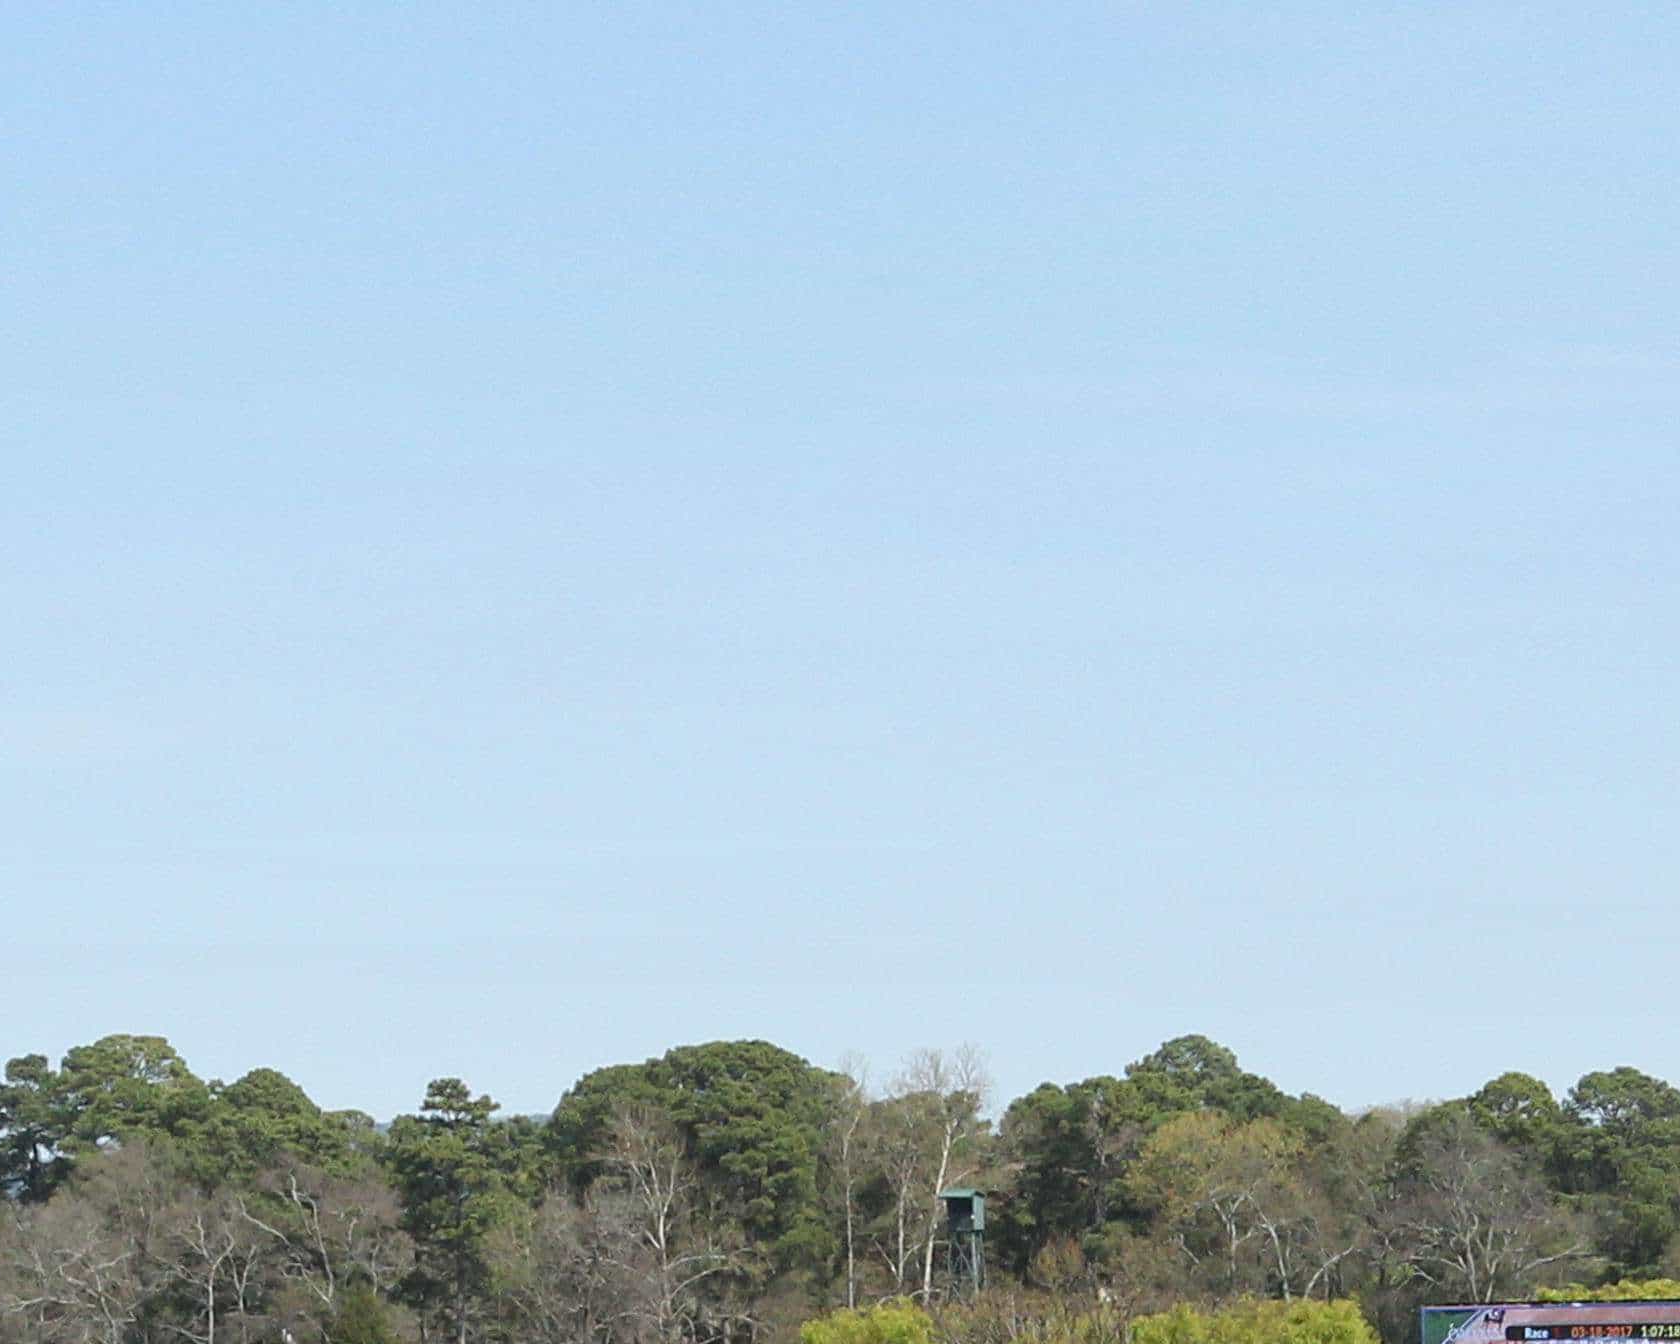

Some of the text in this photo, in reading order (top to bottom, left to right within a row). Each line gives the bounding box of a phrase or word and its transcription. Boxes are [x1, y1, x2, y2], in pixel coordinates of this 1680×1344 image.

[1524, 1327, 1549, 1339] Race
[1571, 1325, 1633, 1338] 03-18-2017
[1641, 1324, 1680, 1337] 1:07:18
